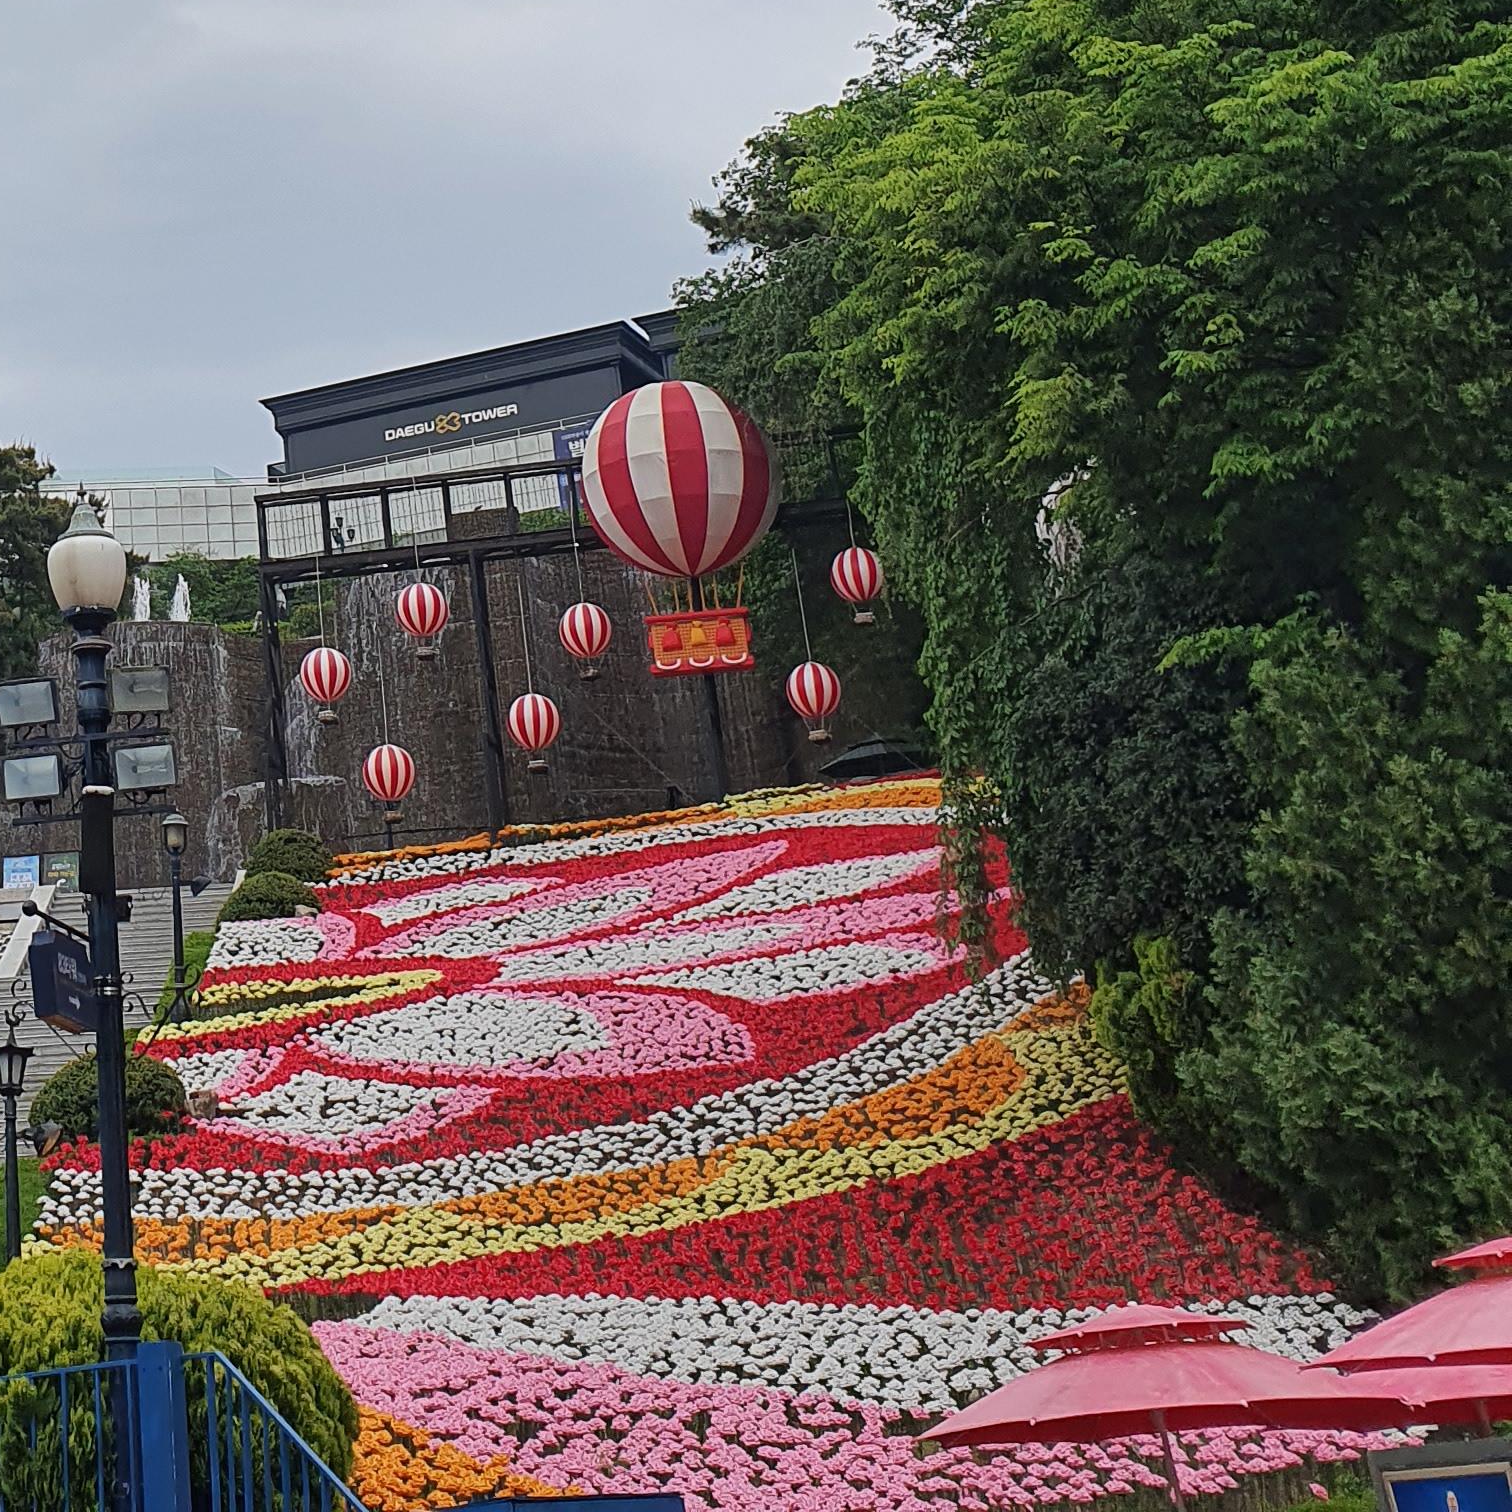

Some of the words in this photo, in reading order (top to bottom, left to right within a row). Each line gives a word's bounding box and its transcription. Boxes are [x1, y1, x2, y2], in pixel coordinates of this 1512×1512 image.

[384, 420, 435, 441] DAEGU
[461, 404, 518, 425] TOWER
[568, 438, 587, 458] 별
